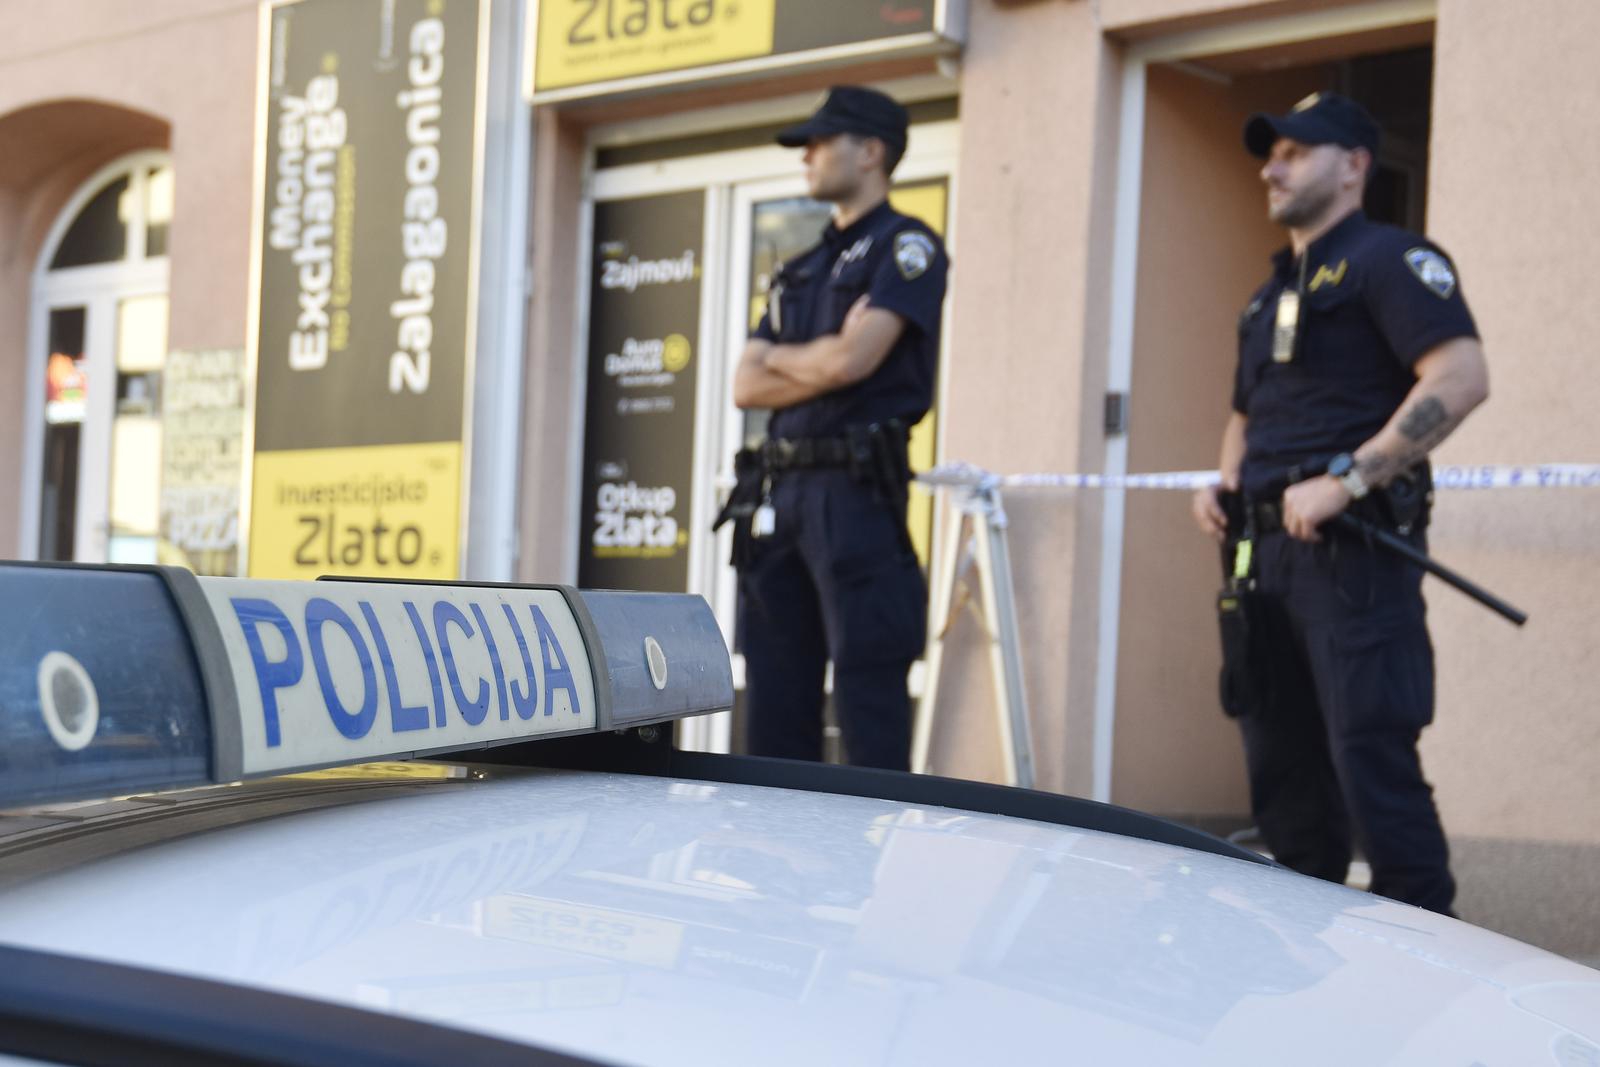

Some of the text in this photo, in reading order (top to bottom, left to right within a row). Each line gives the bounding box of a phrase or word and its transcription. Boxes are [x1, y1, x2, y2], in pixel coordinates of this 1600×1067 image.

[269, 93, 306, 249] Money
[288, 74, 348, 371] Exchange
[389, 17, 447, 393] Zalagaonica
[294, 511, 423, 566] Zlato
[229, 597, 580, 748] POLICIJA
